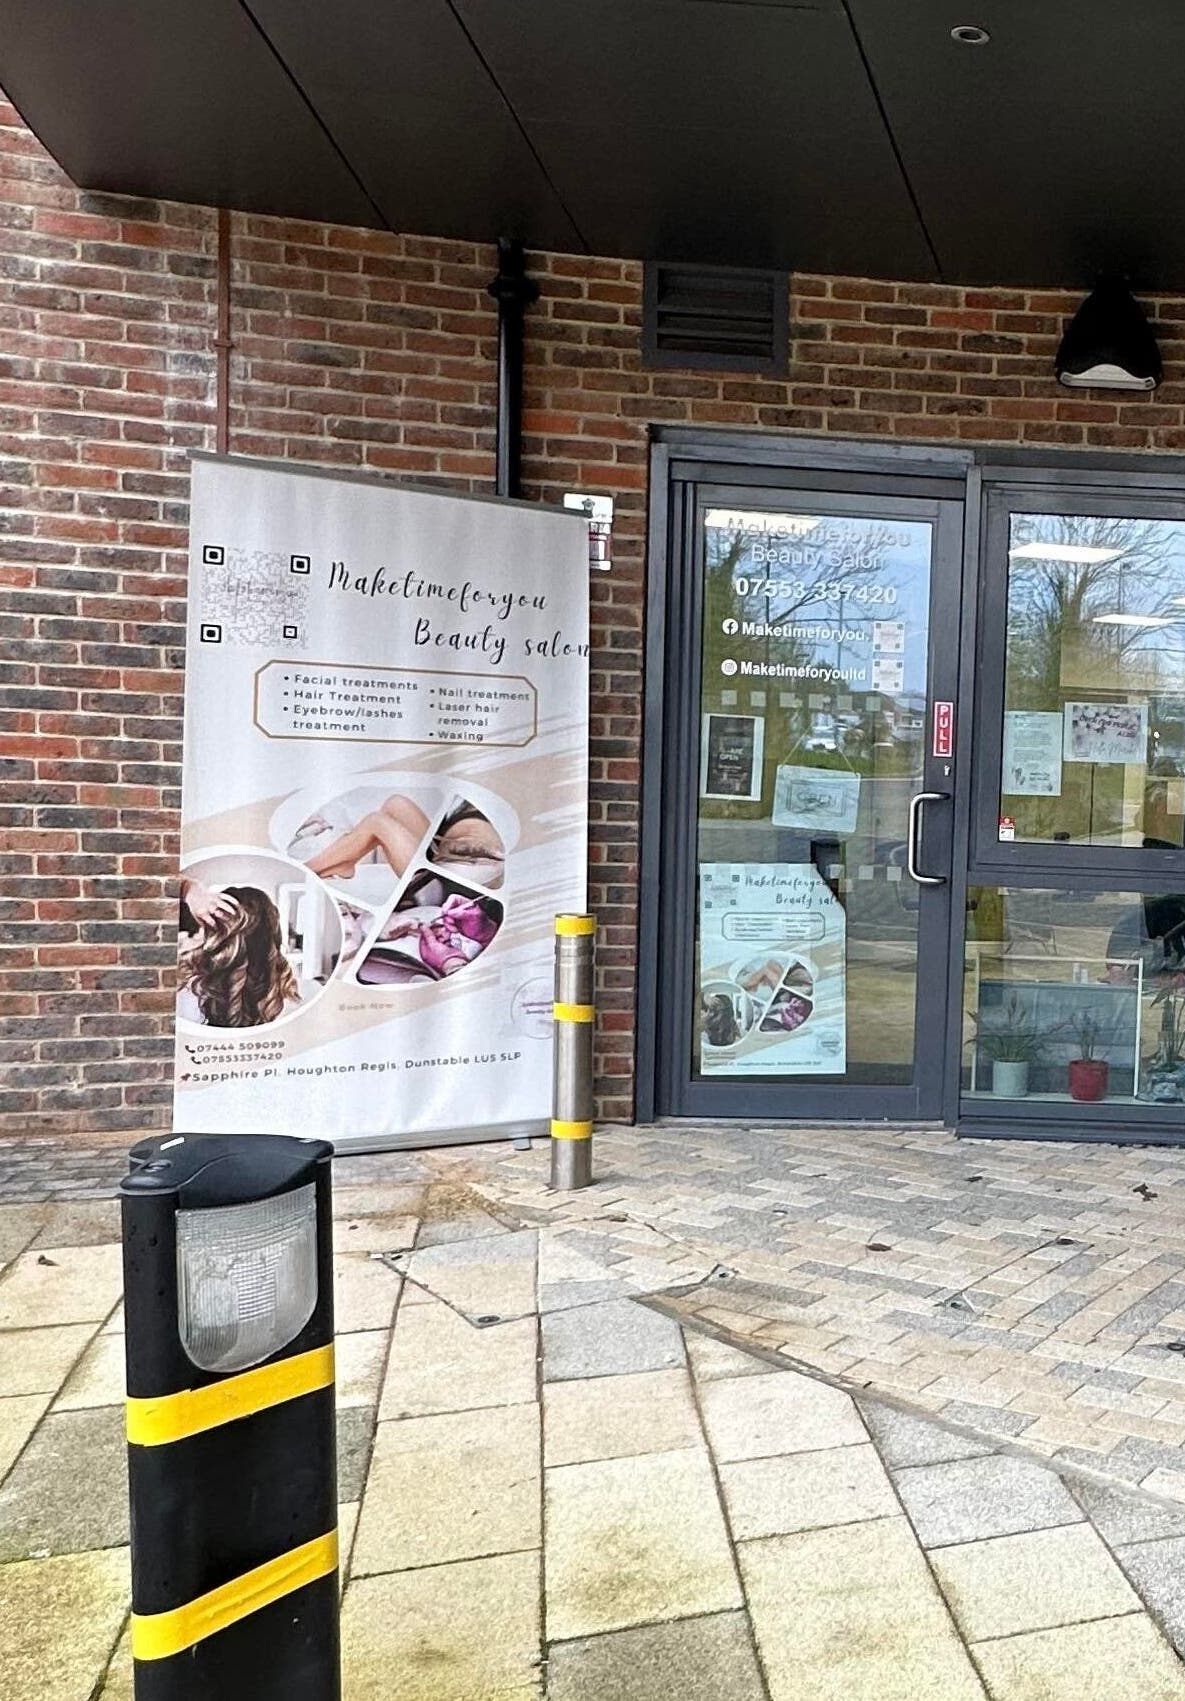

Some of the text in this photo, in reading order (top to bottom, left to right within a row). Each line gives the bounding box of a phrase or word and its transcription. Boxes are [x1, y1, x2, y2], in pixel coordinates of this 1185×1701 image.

[751, 544, 885, 570] Beauty Salon
[328, 561, 548, 620] Maketimeforyou
[735, 576, 806, 599] 07553
[414, 617, 589, 665] Beauty salon
[294, 674, 418, 691] Facial treatments
[294, 689, 402, 704] Hair Treatment
[439, 688, 530, 701] Nail treatment
[293, 704, 403, 718] Eyebrow/lashes
[438, 702, 500, 713] Laser hair
[292, 720, 367, 732] treatment
[438, 717, 489, 727] removal
[939, 705, 949, 753] PULL
[438, 730, 484, 742] Waxing
[191, 1070, 259, 1082] Sapphire
[287, 1064, 356, 1076] Houghton
[405, 1056, 470, 1069] Dunstable
